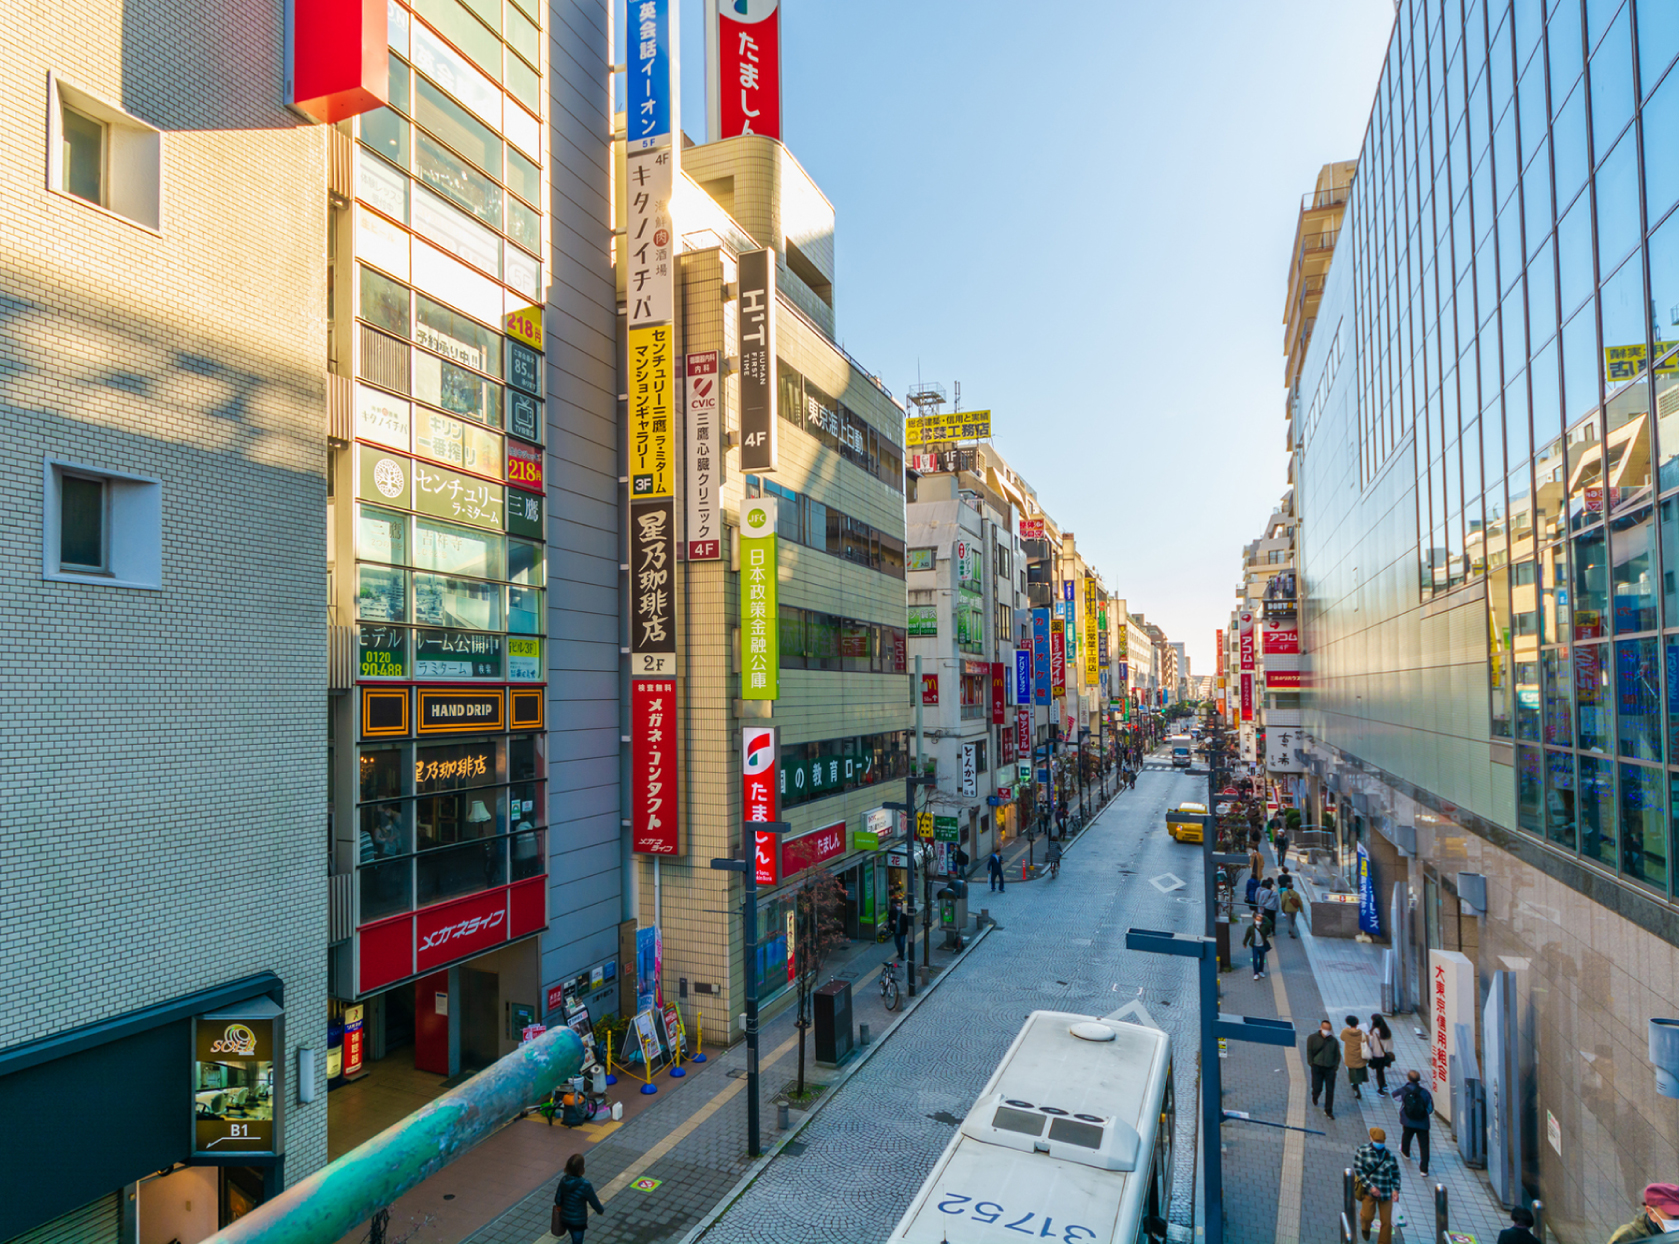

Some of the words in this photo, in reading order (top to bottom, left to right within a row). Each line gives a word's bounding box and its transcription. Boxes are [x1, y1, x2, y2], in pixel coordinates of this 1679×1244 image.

[639, 2, 656, 135] 英会話イーオン
[642, 138, 656, 147] 5F
[655, 153, 669, 165] 4F
[632, 165, 651, 319] キタノイチバ
[513, 268, 532, 291] 5F
[507, 313, 542, 344] 218円
[694, 363, 710, 373] 内科
[635, 346, 650, 468] マンションギャラリー
[691, 398, 716, 409] CVIC
[430, 416, 463, 439] キリン
[808, 396, 864, 456] 東京海上日動
[744, 431, 767, 447] 4F
[417, 436, 477, 466] 一番搾り
[943, 451, 957, 462] 1F
[508, 459, 542, 482] 218円
[696, 412, 710, 538] 三鷹心臓クリニック
[416, 469, 504, 508] センチュリー
[635, 478, 652, 490] 3F
[452, 502, 499, 524] ラ・ミターム
[508, 494, 539, 522] 三鷹
[748, 513, 765, 523] JFC
[694, 543, 714, 556] 4F
[637, 509, 669, 648] 星乃珈琲店
[750, 549, 767, 689] 日本政策金融公庫
[1242, 636, 1253, 662] アコム
[1270, 633, 1298, 642] アコム
[366, 650, 391, 664] 0120
[418, 661, 467, 675] ラミターム
[643, 655, 665, 671] 2F
[638, 684, 672, 692] 検査無料
[432, 704, 465, 717] HAND
[466, 704, 493, 716] DRIP
[1020, 720, 1029, 749] アイフル
[647, 698, 663, 830] メガネ・コンタクト
[964, 746, 975, 786] とんかつ
[230, 1124, 248, 1137] B1
[937, 1192, 1097, 1244] 31752
